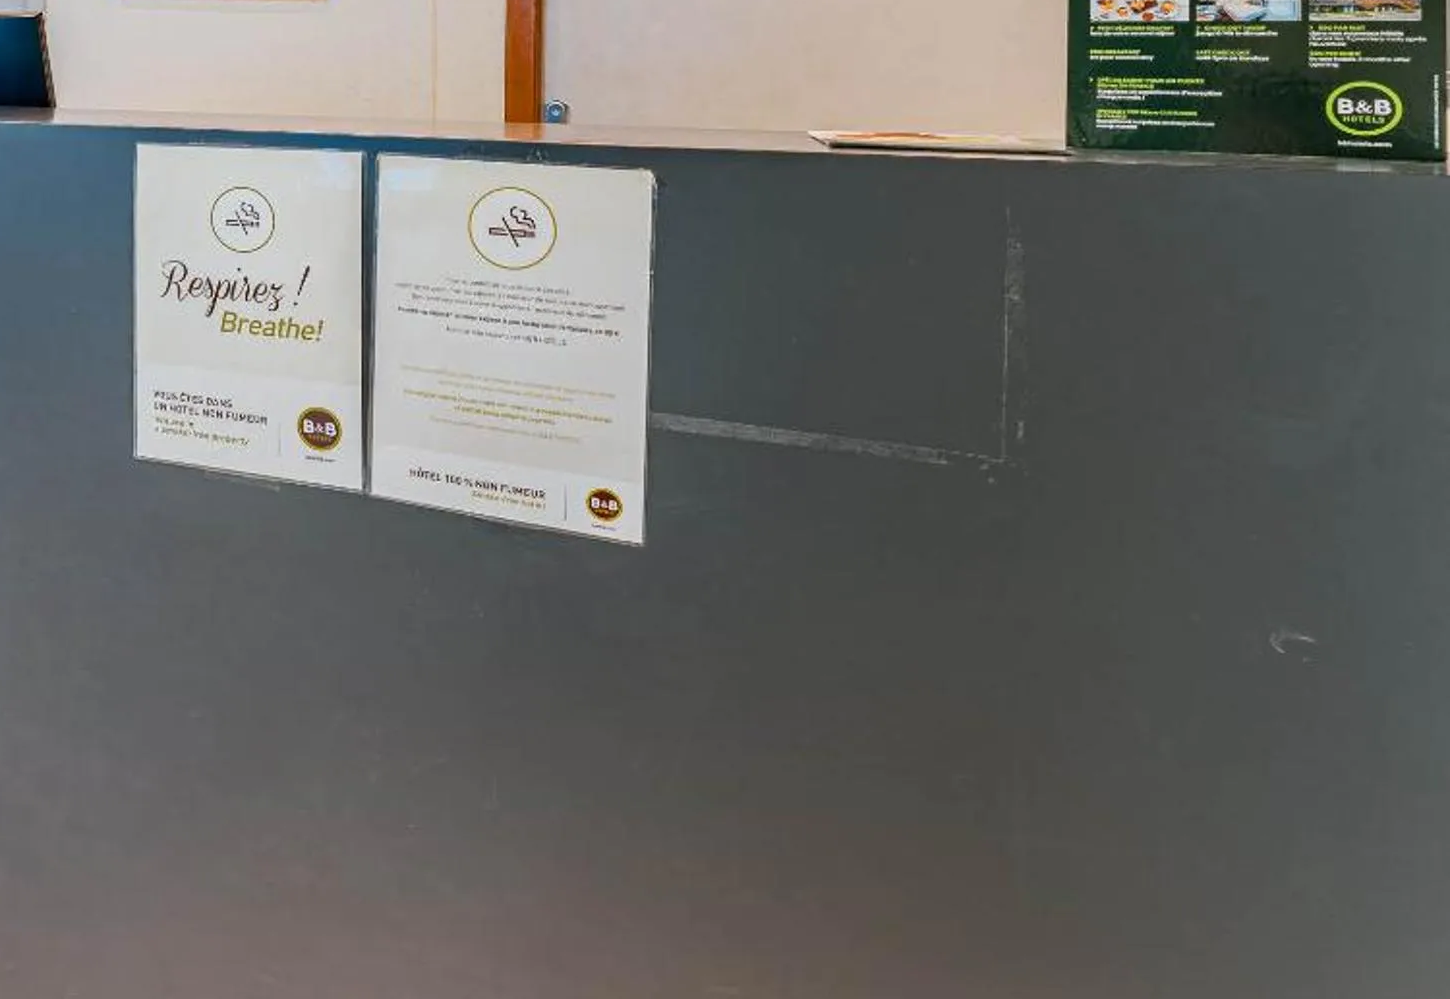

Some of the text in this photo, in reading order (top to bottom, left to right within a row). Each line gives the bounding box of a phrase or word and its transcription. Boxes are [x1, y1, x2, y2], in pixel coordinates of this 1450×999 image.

[1337, 98, 1392, 115] B&B
[1342, 114, 1386, 124] HOTELS
[220, 310, 325, 342] Breathe!
[303, 418, 337, 438] B&B
